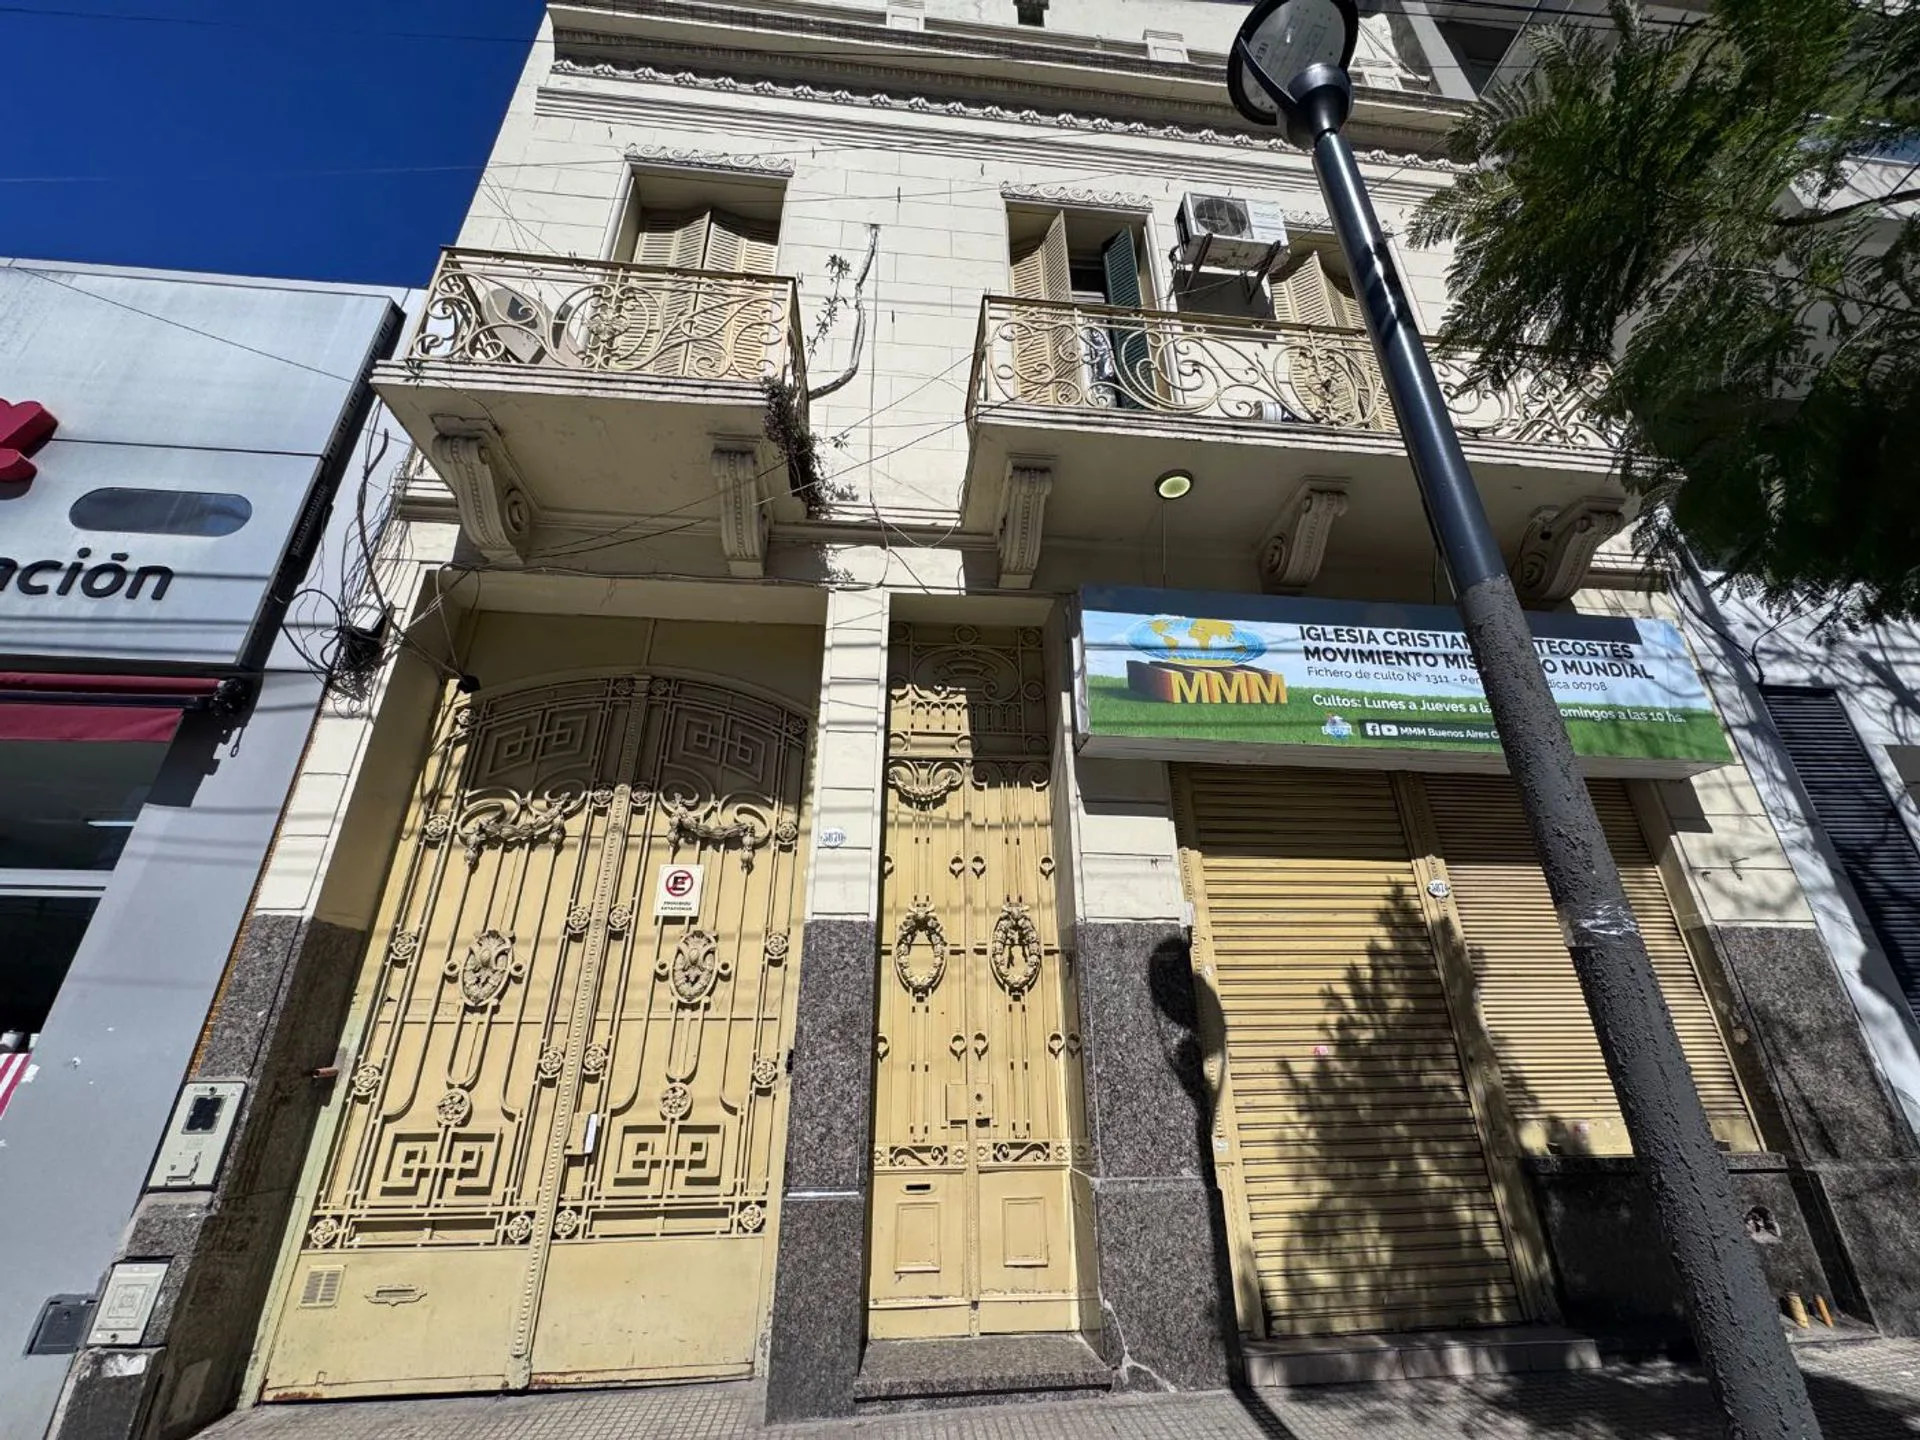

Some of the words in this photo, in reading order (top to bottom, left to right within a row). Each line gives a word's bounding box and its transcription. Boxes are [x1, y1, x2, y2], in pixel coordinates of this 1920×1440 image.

[1299, 625, 1380, 646] IGLESIA
[1302, 645, 1439, 668] MOVIMIENTO
[1561, 659, 1655, 680] MUNDIAL
[1170, 671, 1288, 704] MMM
[1307, 666, 1352, 679] Fichero
[1354, 668, 1371, 680] de
[1373, 670, 1405, 682] culto
[1425, 673, 1449, 684] 1311
[1571, 681, 1608, 692] 00708
[1312, 694, 1361, 708] Cultos:
[1364, 696, 1406, 710] Lunes
[1408, 702, 1418, 711] a
[1420, 699, 1467, 713] Jueves
[1469, 704, 1478, 713] a
[1479, 702, 1492, 714] la
[1559, 706, 1616, 721] omingos
[1618, 711, 1627, 720] a
[1627, 709, 1648, 721] las
[1649, 711, 1665, 721] 10
[1666, 710, 1687, 723] hs.
[1399, 726, 1426, 737] MMM
[1427, 727, 1465, 739] Buenos
[1466, 728, 1490, 739] Aires
[672, 876, 686, 891] E
